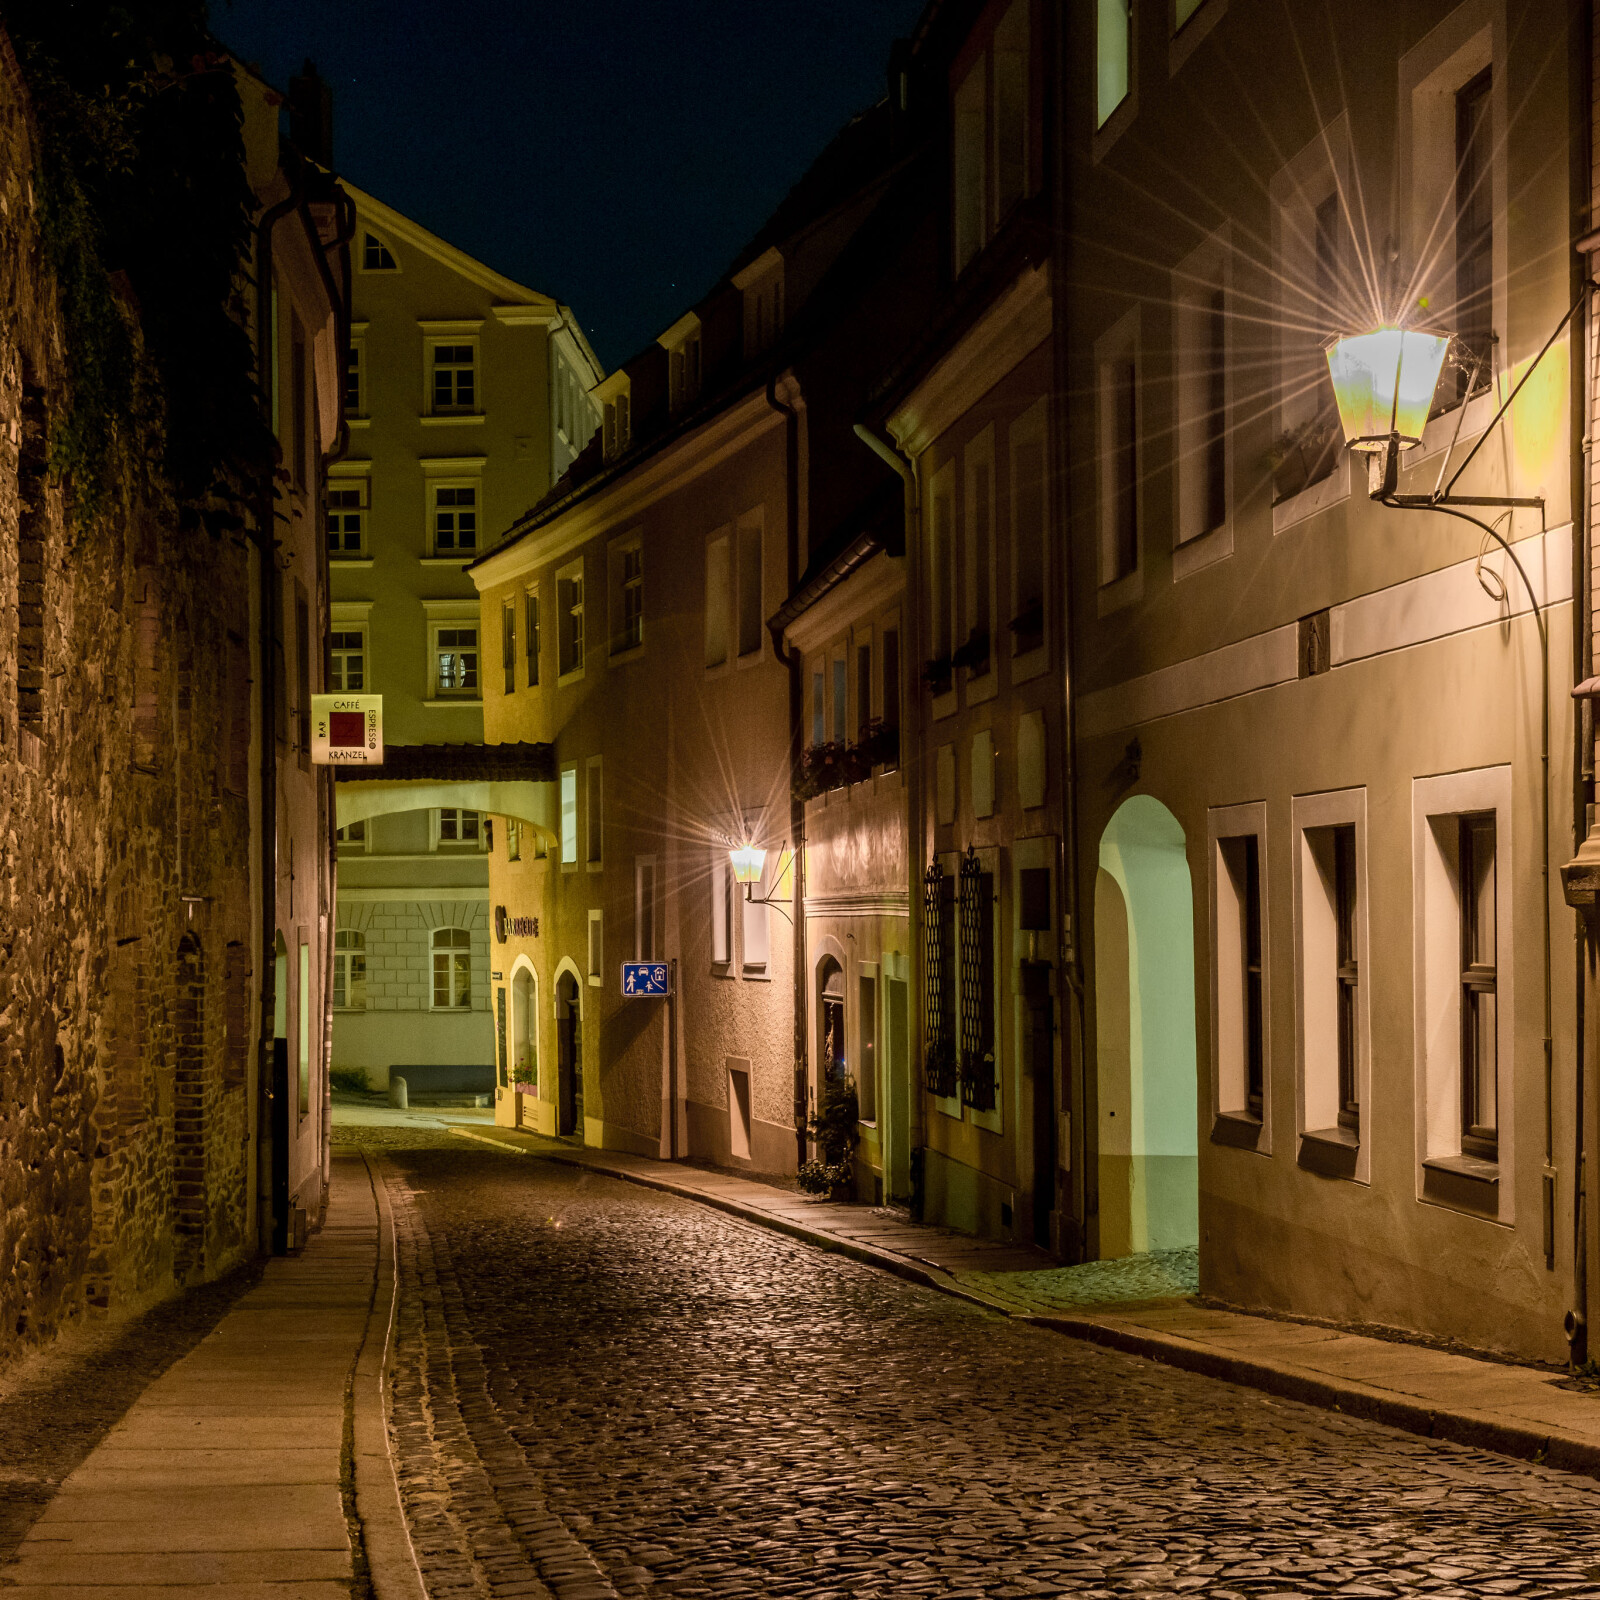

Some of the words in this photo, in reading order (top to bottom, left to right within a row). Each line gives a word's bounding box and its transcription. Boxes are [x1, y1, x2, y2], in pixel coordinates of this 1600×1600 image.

[318, 721, 326, 738] BAR
[368, 709, 377, 750] ESPRESSO
[328, 750, 368, 760] KRÄNZEL
